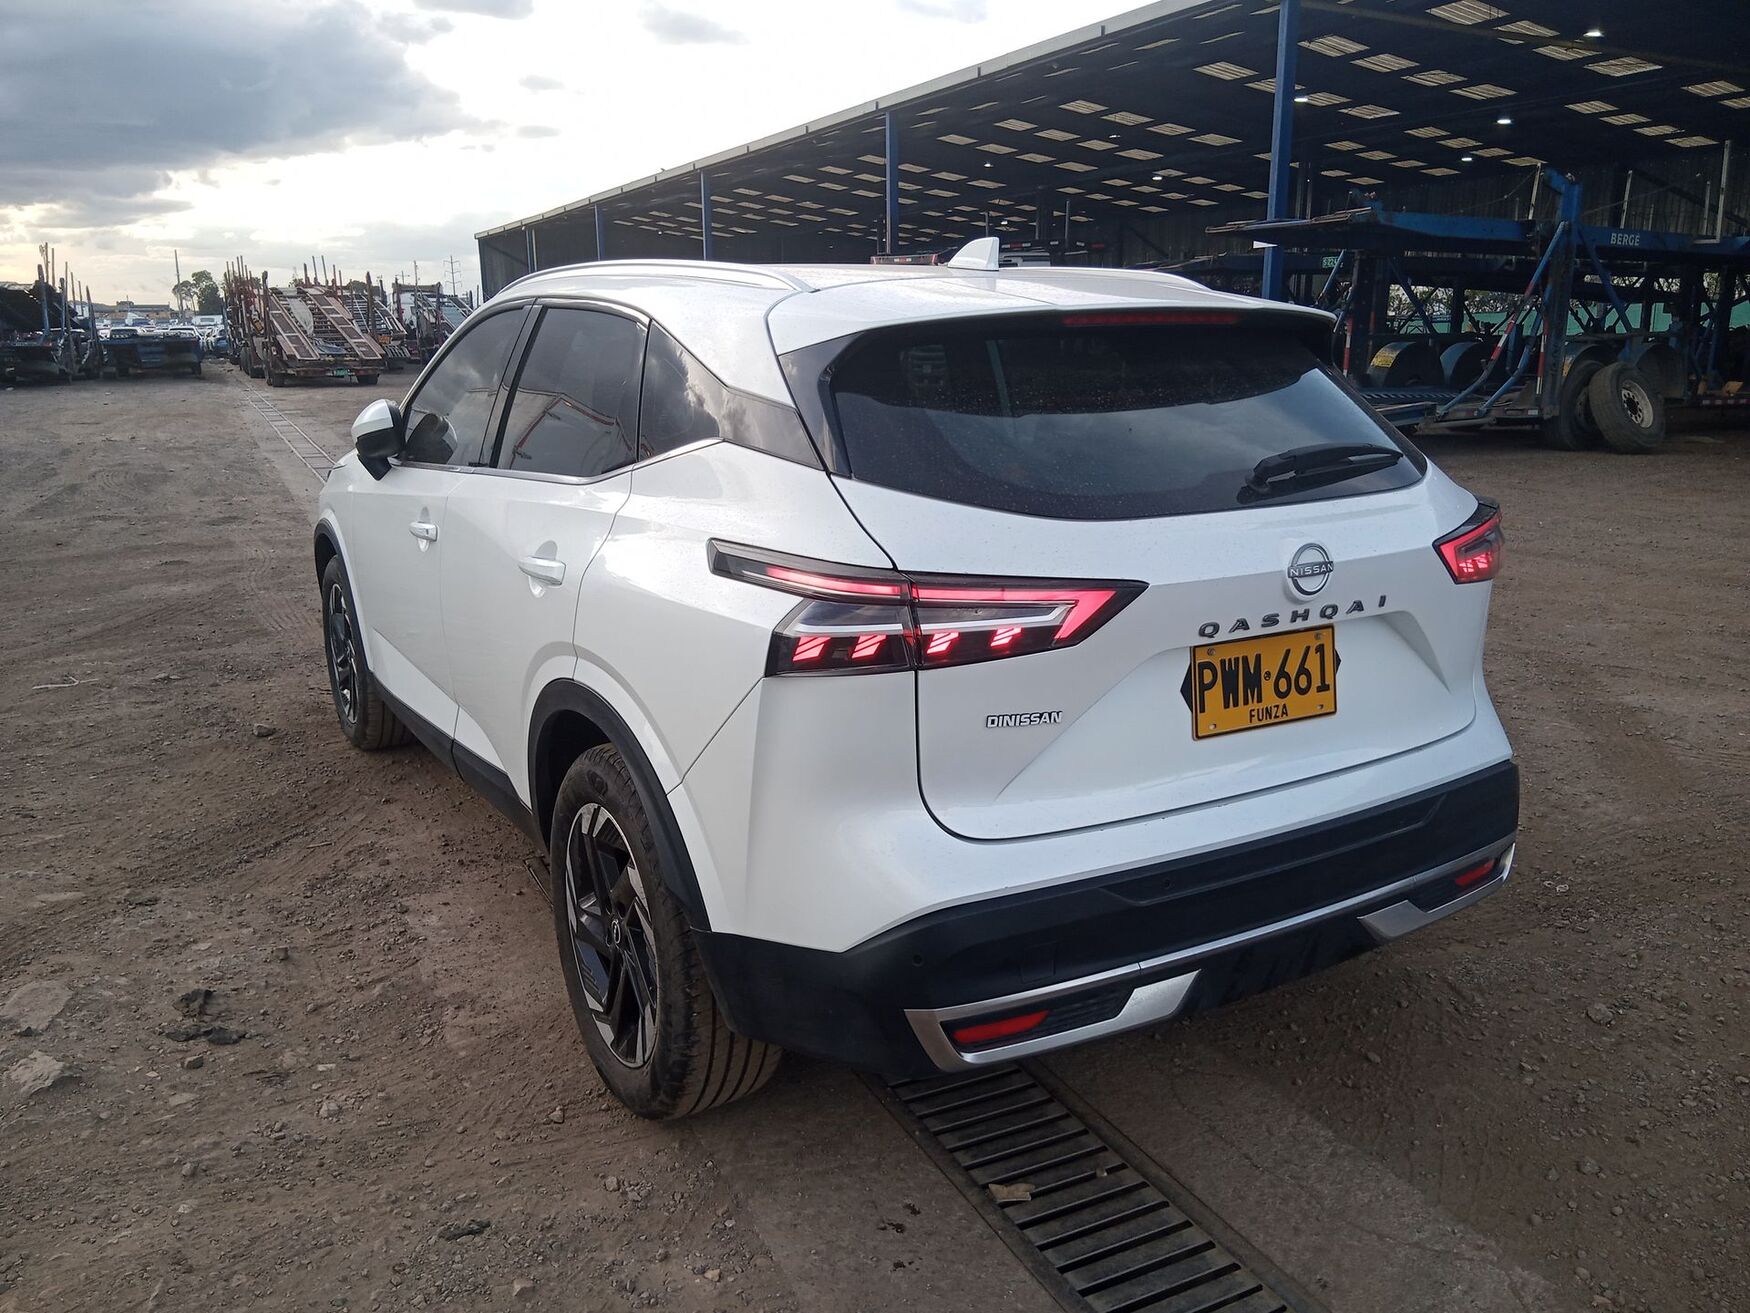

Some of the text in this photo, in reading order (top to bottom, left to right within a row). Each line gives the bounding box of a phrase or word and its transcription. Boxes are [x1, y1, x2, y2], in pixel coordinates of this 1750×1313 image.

[1289, 562, 1334, 577] NISSAN
[1198, 594, 1387, 639] QASHQAI
[1197, 643, 1330, 714] PWM 661
[986, 710, 1063, 729] DINISSAN
[1249, 703, 1289, 723] FUNZA
